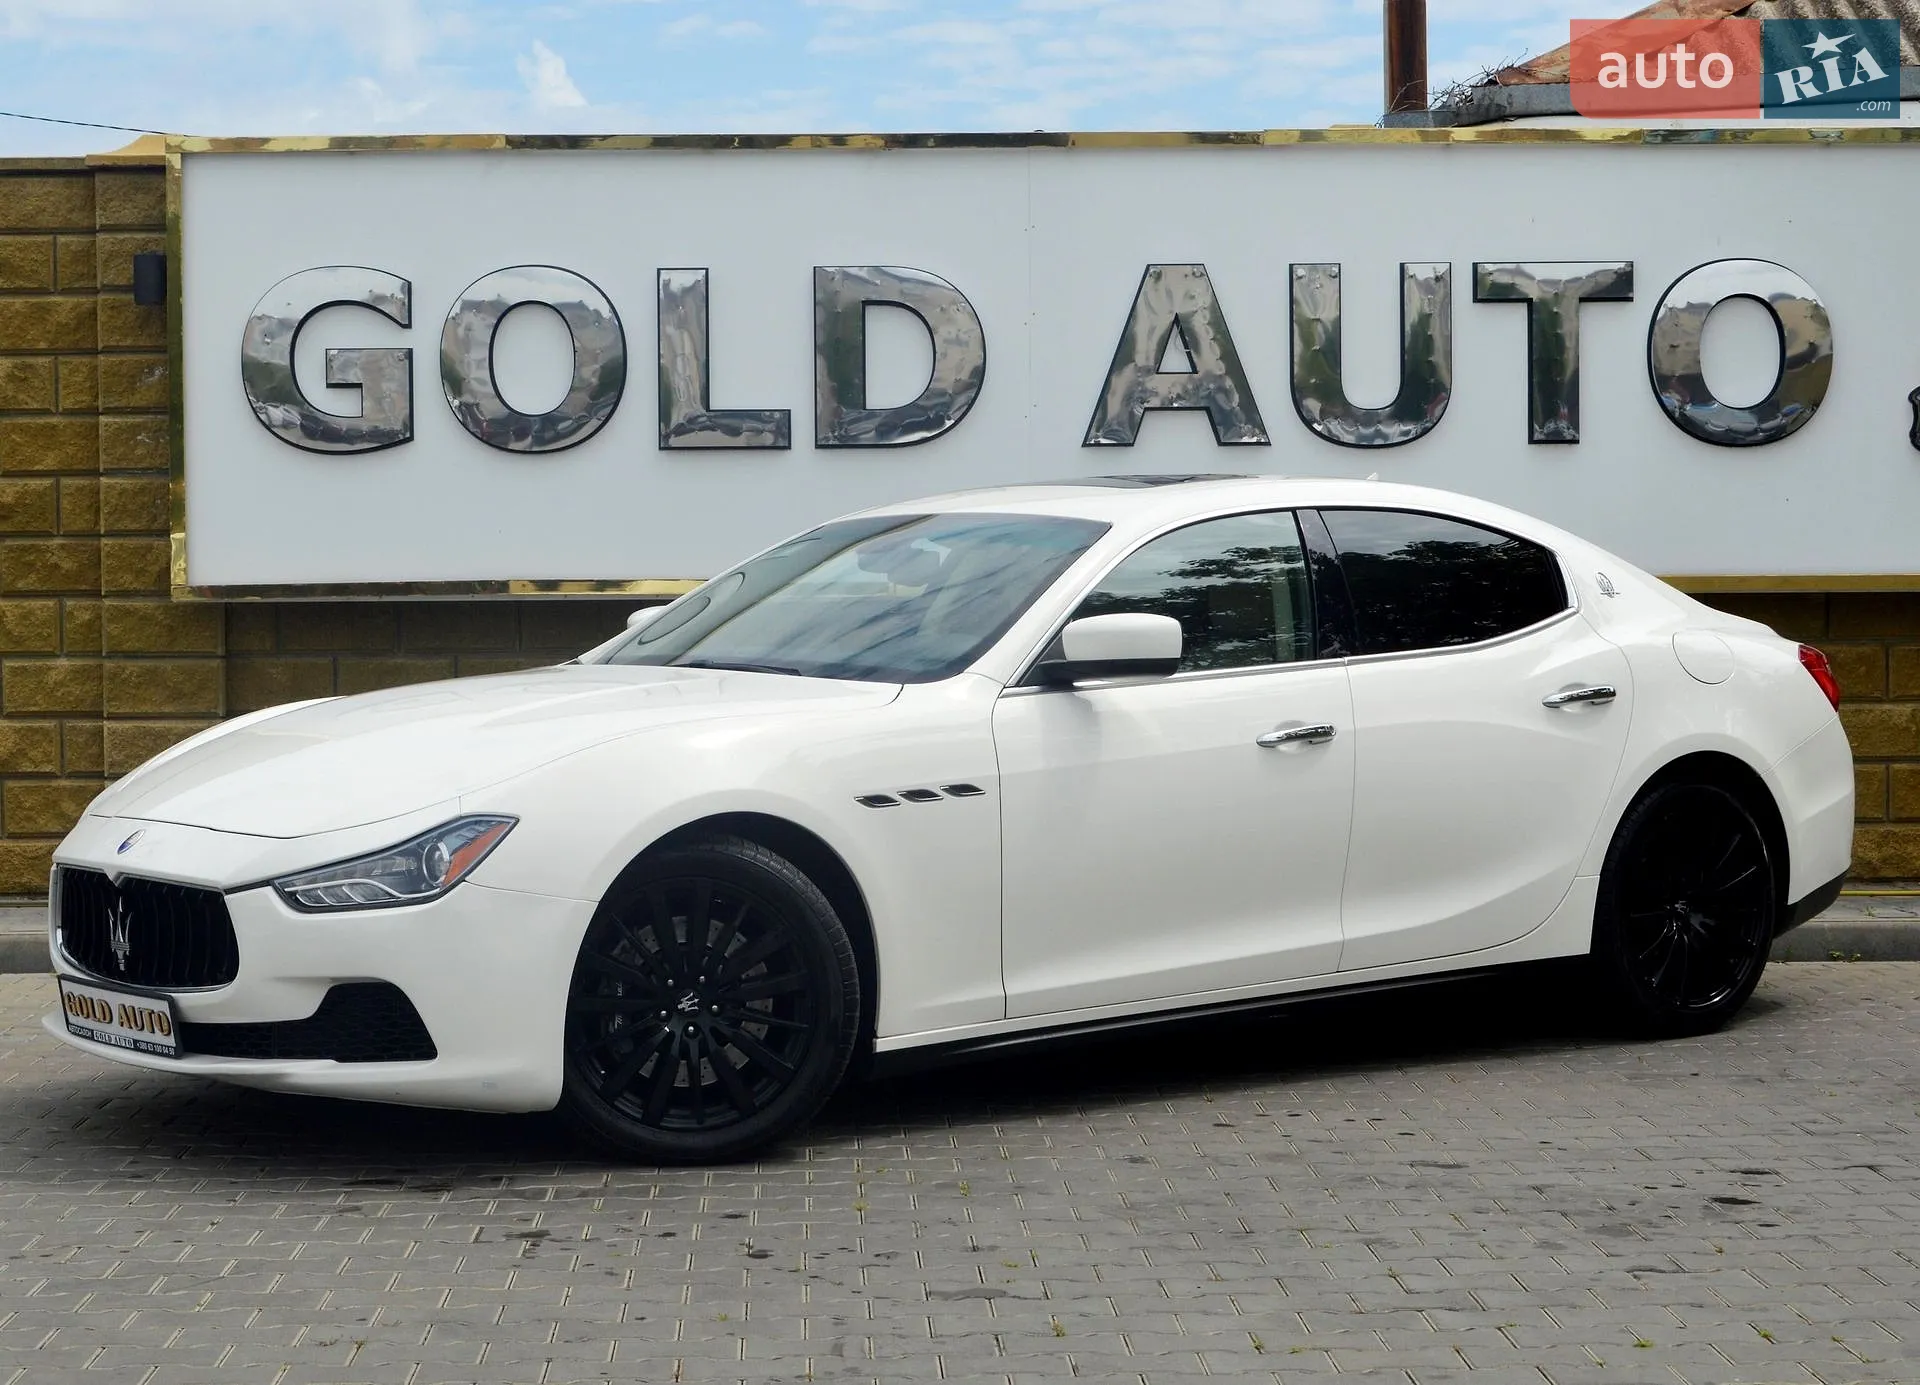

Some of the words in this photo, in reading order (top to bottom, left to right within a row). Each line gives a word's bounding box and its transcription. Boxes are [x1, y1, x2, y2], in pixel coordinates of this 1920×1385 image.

[241, 264, 987, 455] GOLD
[1081, 258, 1834, 447] AUTO
[64, 991, 114, 1024] GOLD
[118, 1003, 171, 1036] AUTO
[94, 1030, 113, 1043] GOLD
[114, 1036, 134, 1048] AUTO
